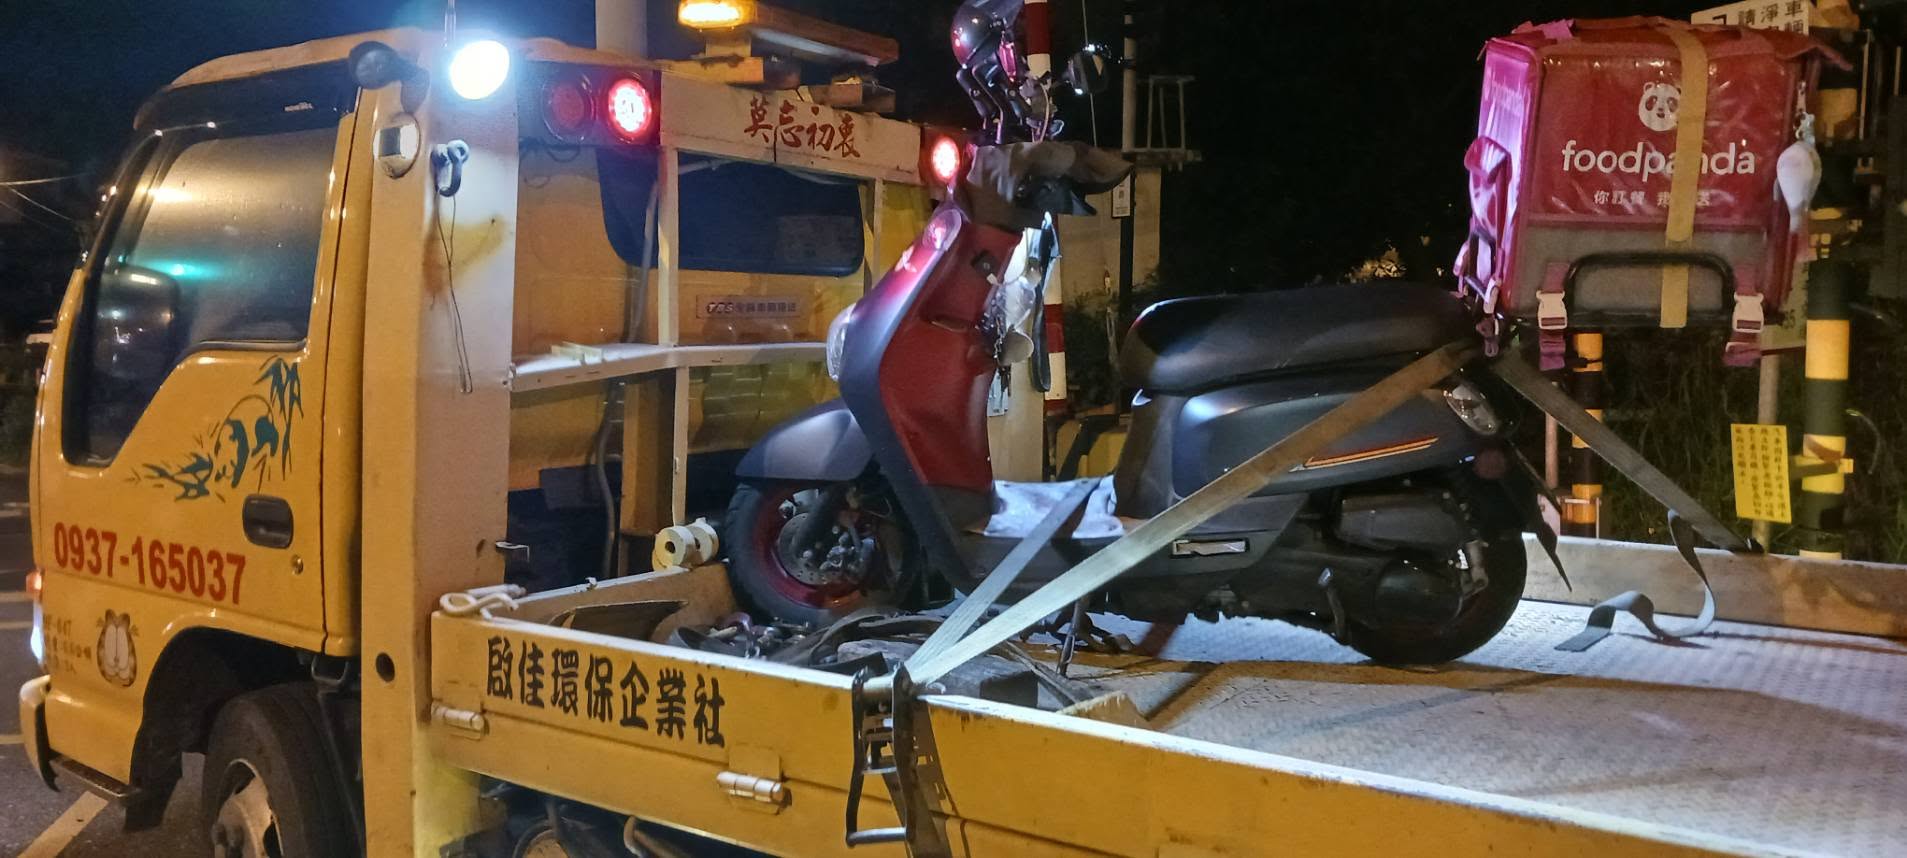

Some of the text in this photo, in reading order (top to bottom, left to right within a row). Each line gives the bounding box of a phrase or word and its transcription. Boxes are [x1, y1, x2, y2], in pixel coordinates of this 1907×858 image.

[744, 93, 860, 158] 莫忘初衷
[53, 521, 247, 606] 0937-165037
[486, 635, 727, 748] 啟佳環保企業社
